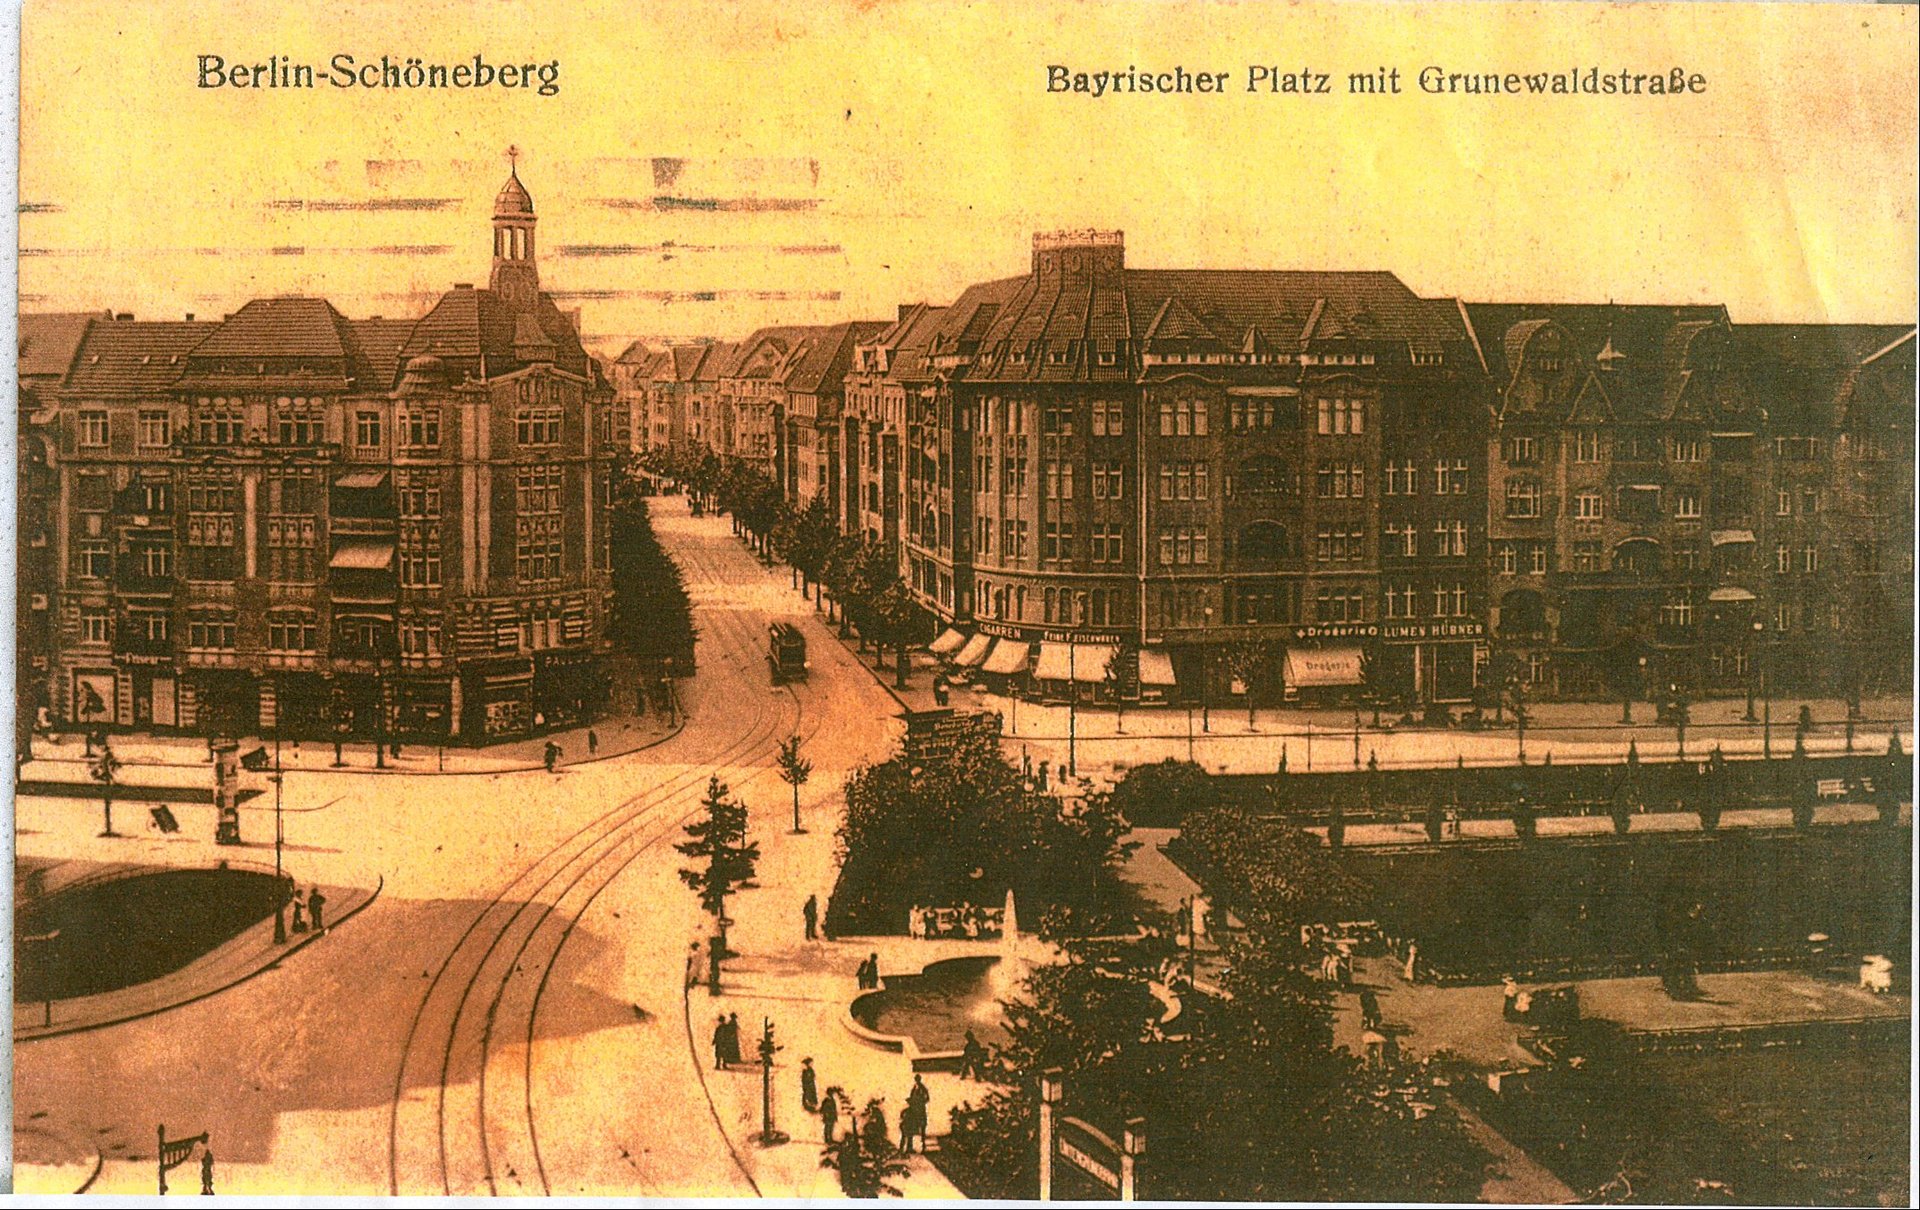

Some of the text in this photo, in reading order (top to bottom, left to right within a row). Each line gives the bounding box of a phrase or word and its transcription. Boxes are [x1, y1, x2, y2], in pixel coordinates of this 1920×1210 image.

[979, 623, 1022, 639] CIGARREN
[1307, 626, 1366, 637] Drogerie
[1432, 619, 1483, 637] HÜBNER
